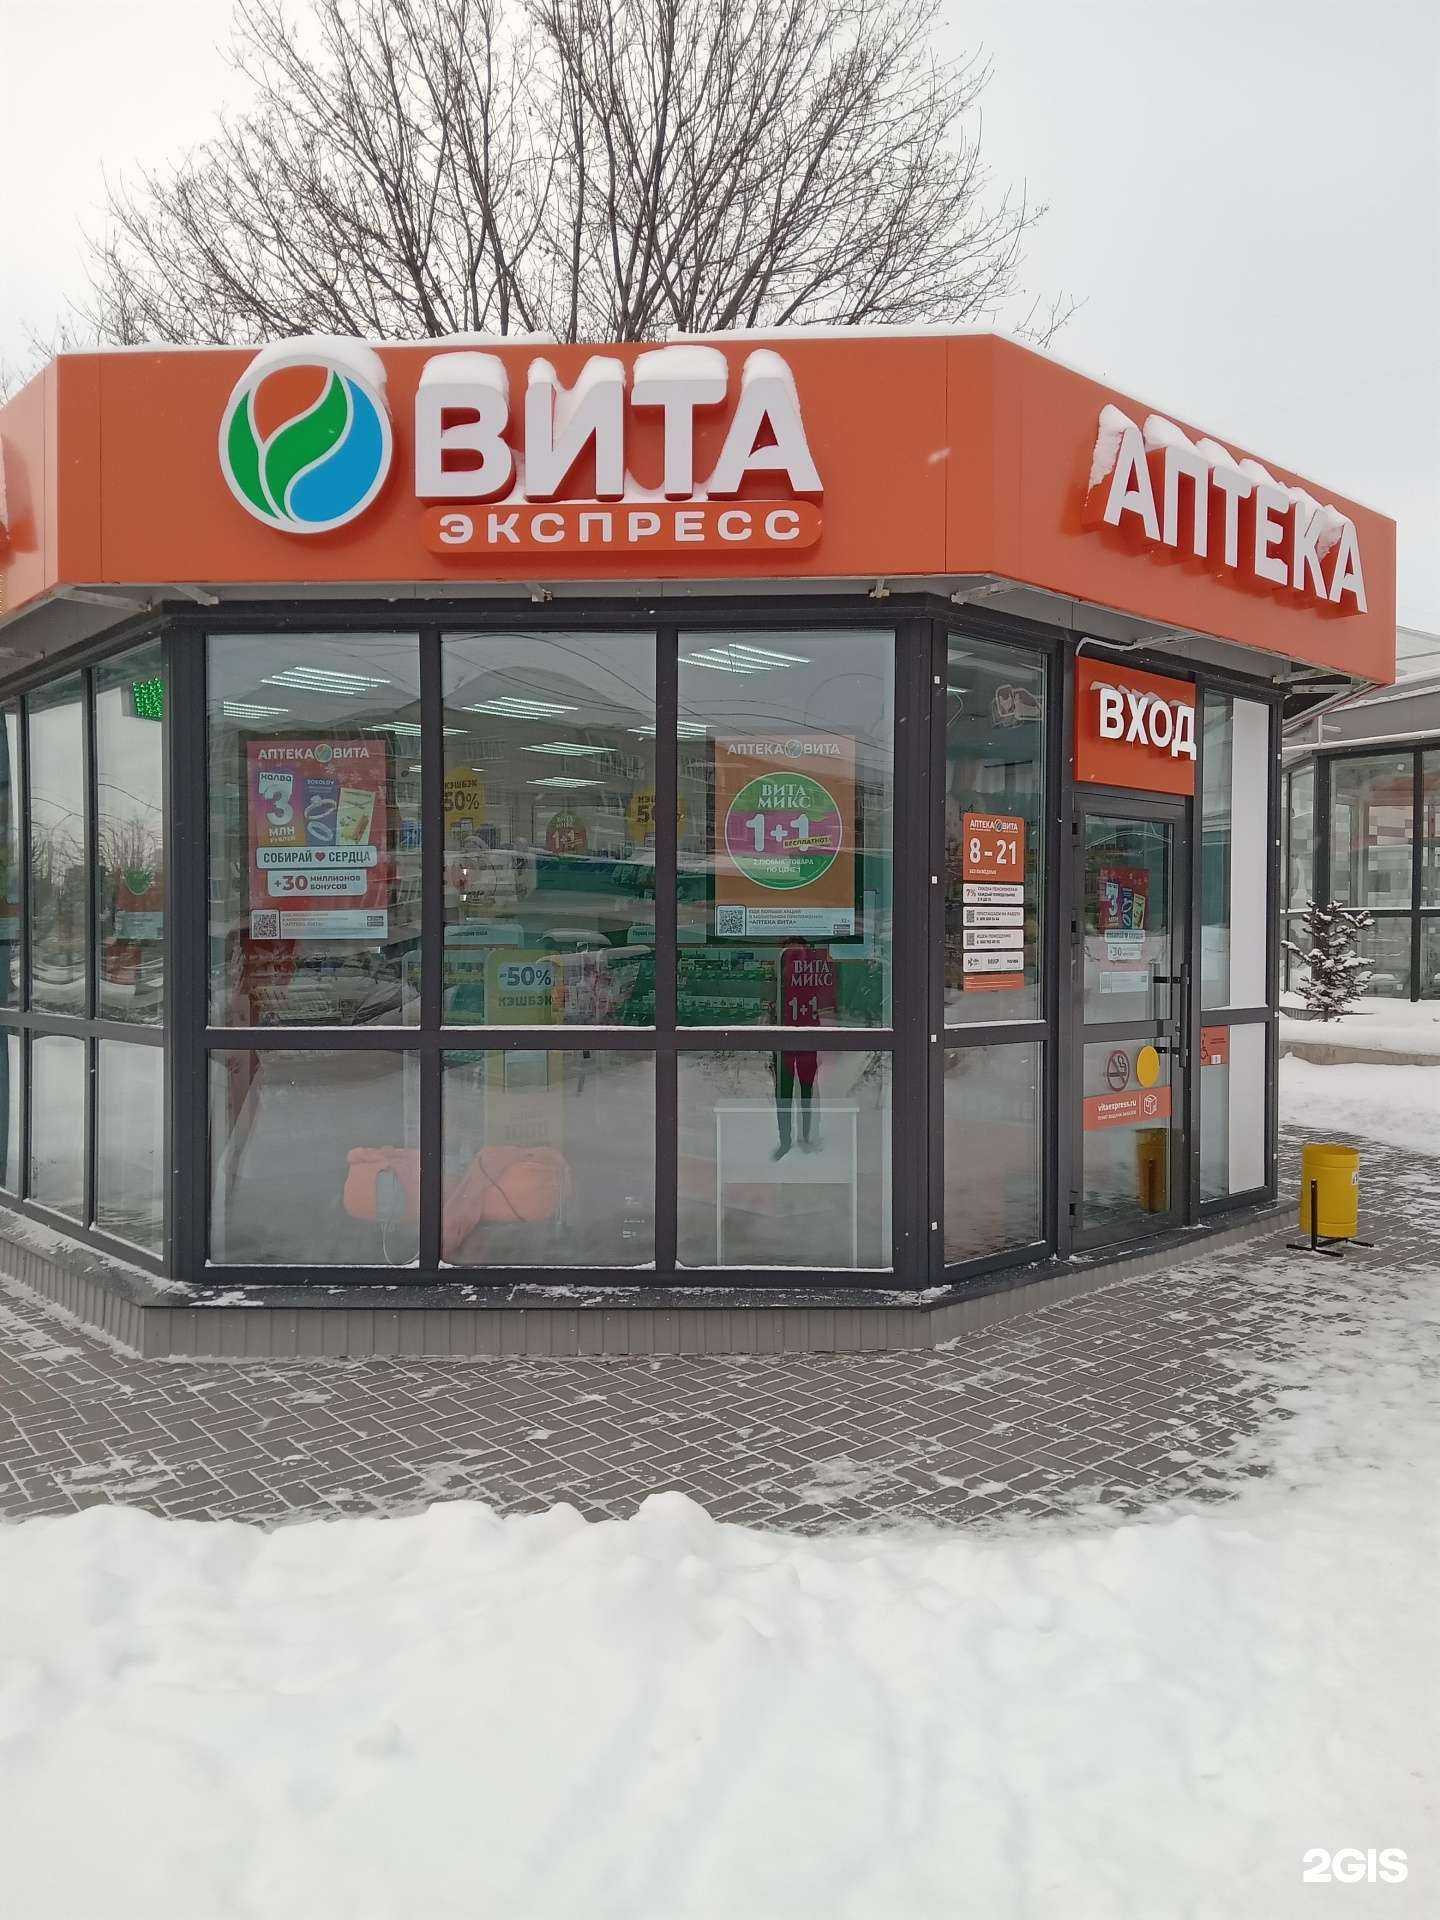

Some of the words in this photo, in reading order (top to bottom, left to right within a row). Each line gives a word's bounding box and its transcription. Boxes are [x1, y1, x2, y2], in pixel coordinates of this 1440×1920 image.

[414, 376, 824, 501] ВИТА
[1103, 422, 1368, 613] АПТЕКА
[439, 509, 802, 545] ЭКСПРЕСС
[1098, 685, 1198, 761] ВХОД
[258, 748, 314, 760] АПТЕКА
[332, 746, 370, 759] ВИТА
[727, 743, 785, 756] АПТЕКА
[803, 743, 841, 756] ВИТА
[761, 783, 807, 796] ВИТА
[757, 795, 813, 809] МИКС
[268, 826, 295, 838] МЛН
[970, 819, 994, 829] АПТЕКА
[1002, 822, 1019, 831] ВИТА
[263, 848, 313, 863] СОБИРАЙ
[328, 850, 371, 864] СЕРДЦА
[274, 876, 308, 891] +30
[310, 874, 361, 883] МИЛЛИОНОВ
[310, 882, 347, 891] БОНУСОВ
[792, 960, 829, 973] ВИТА
[507, 966, 552, 986] 50%
[791, 973, 833, 987] МИКС
[498, 994, 552, 1007] КЭШБЭК
